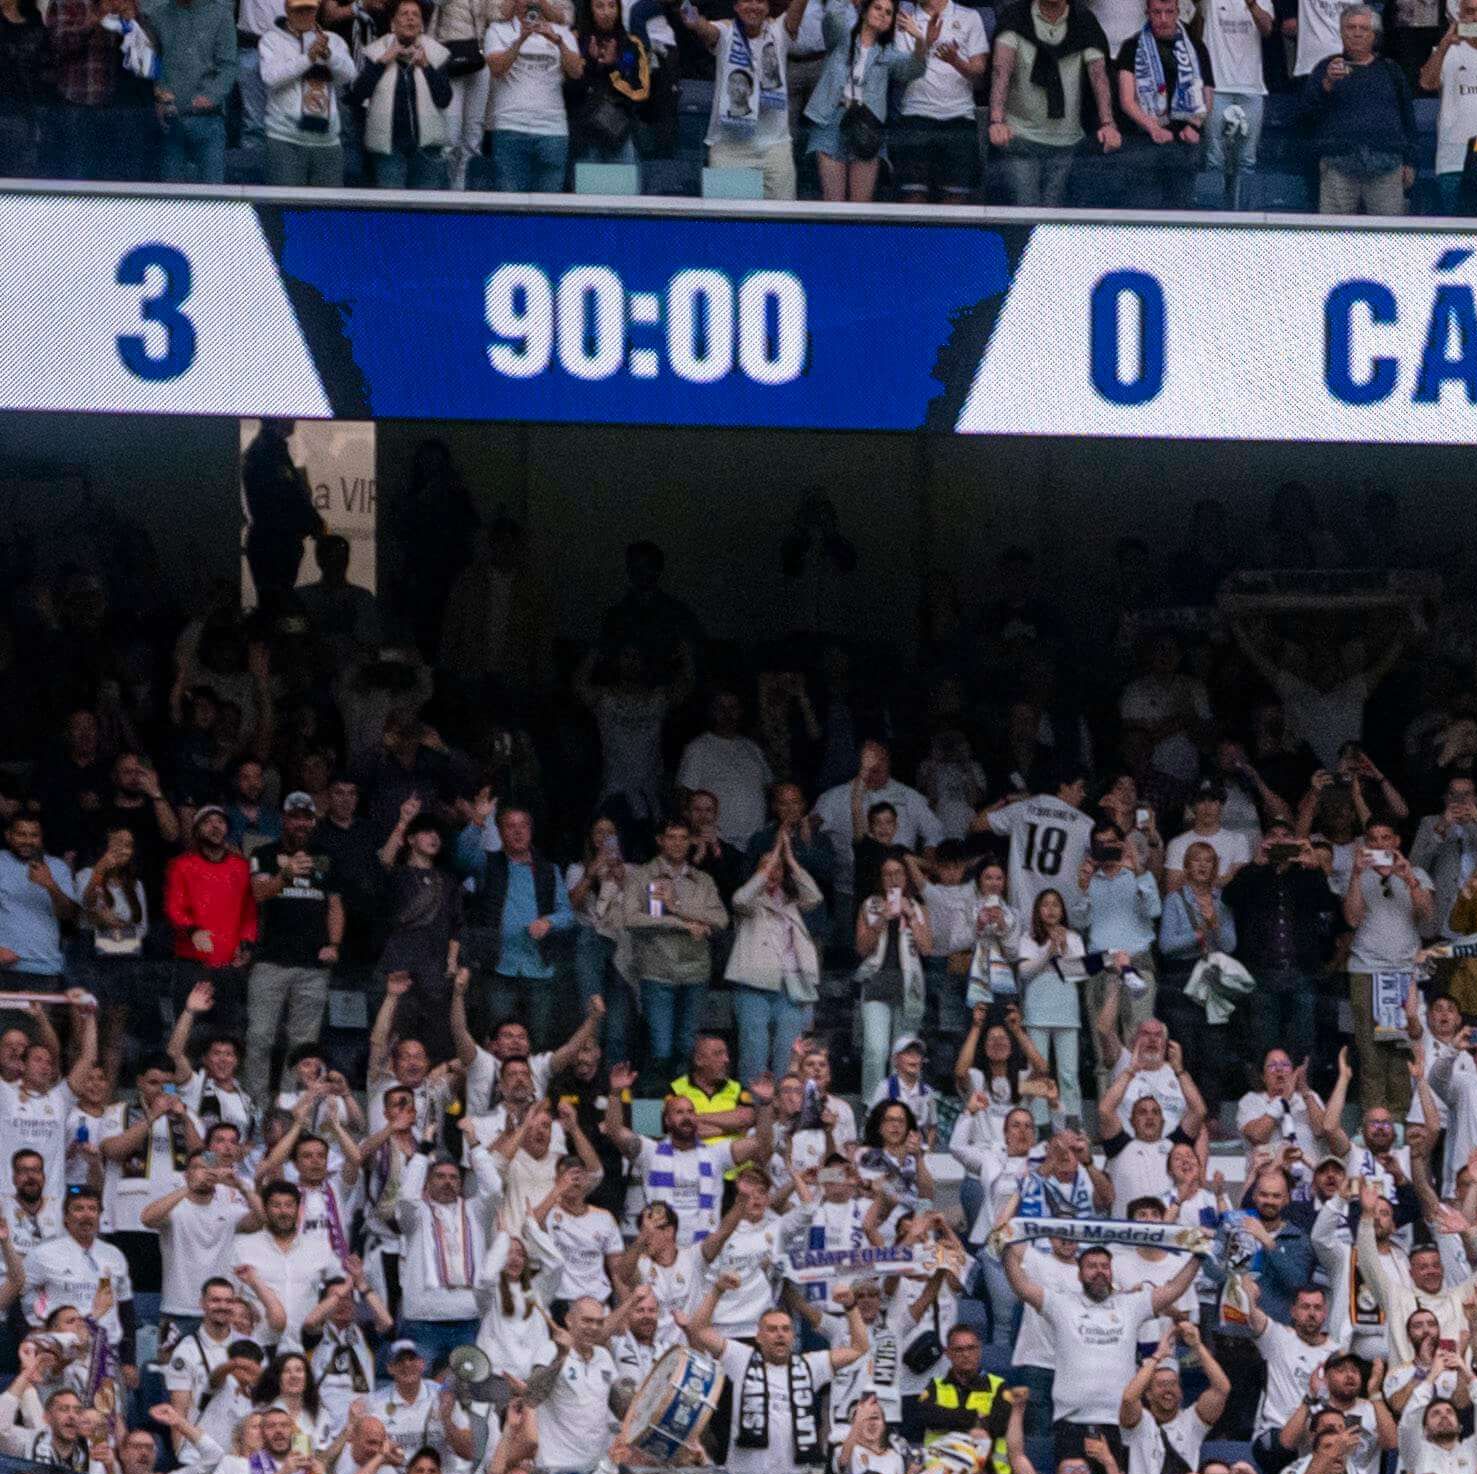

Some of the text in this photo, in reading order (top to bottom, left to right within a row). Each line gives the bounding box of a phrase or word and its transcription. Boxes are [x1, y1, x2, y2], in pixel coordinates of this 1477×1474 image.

[114, 243, 1166, 406] 3 90:00 0
[1021, 823, 1068, 877] 18
[1023, 1219, 1166, 1243] Real Madrid
[788, 1243, 914, 1271] CAMPEONES
